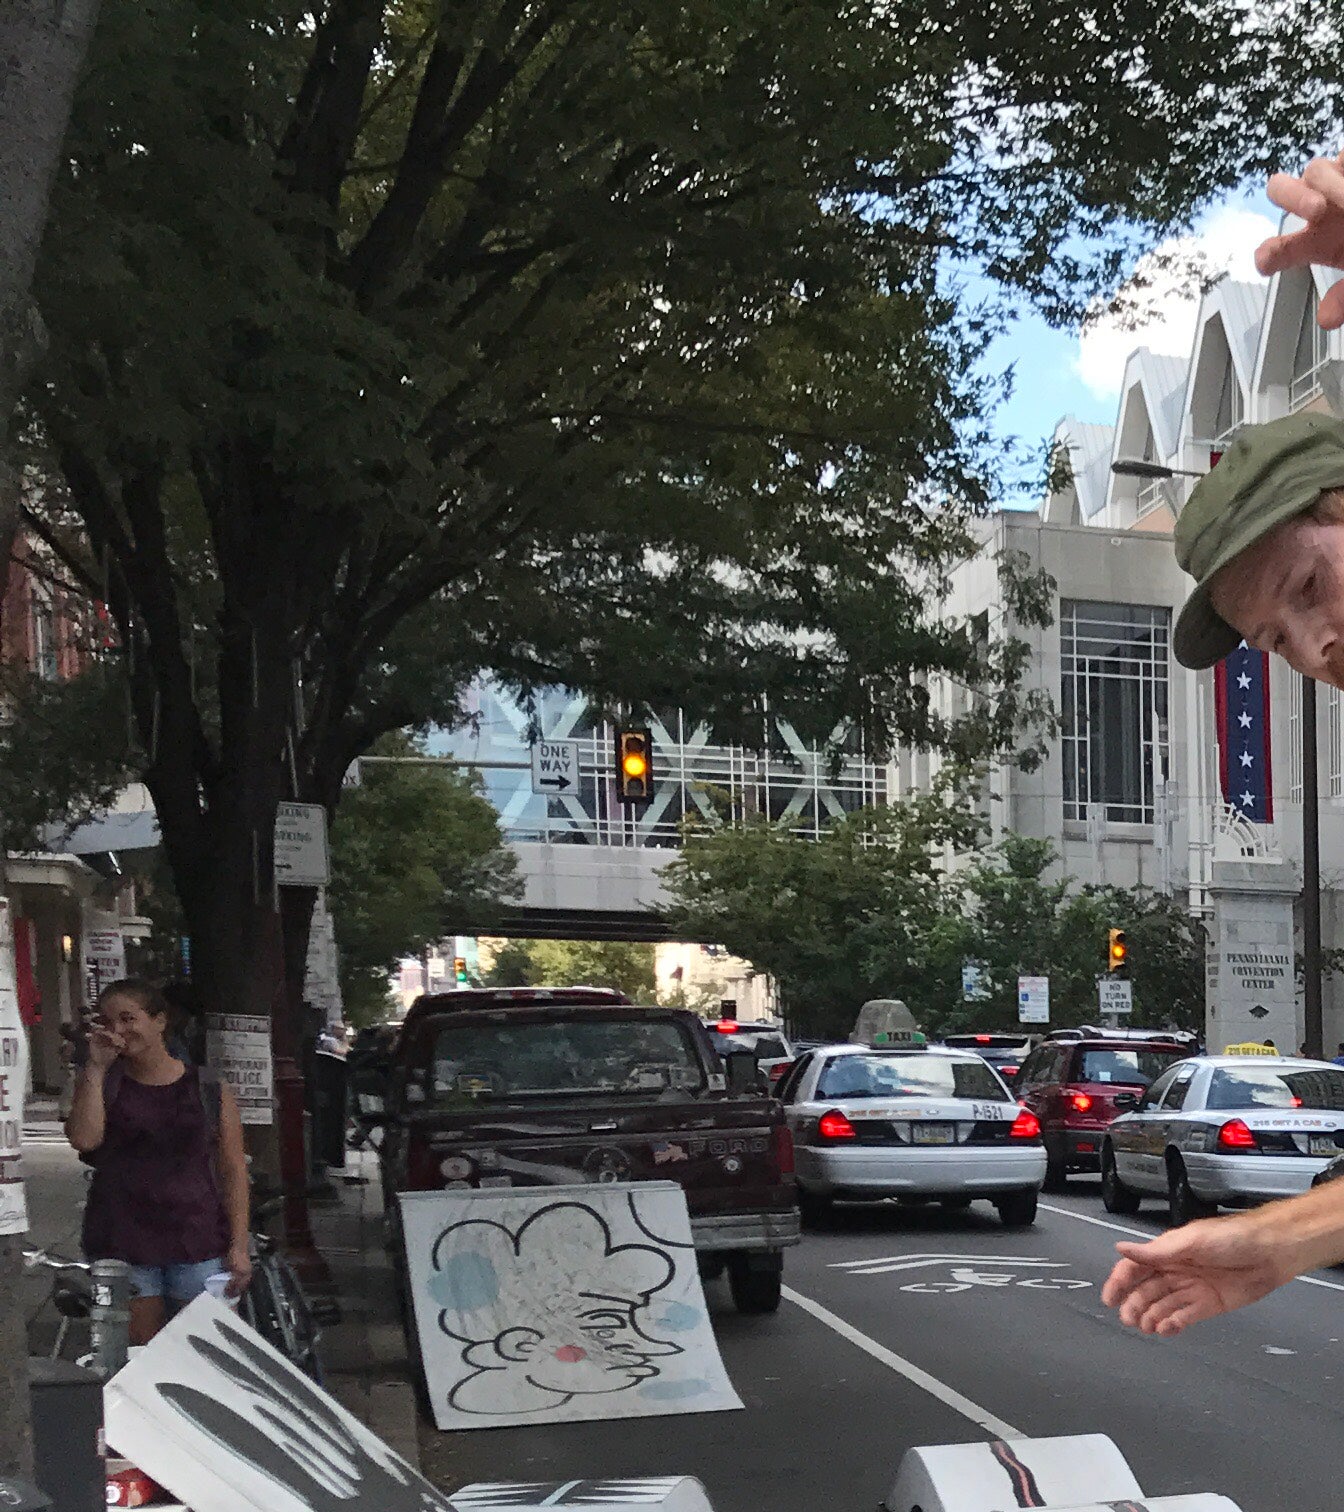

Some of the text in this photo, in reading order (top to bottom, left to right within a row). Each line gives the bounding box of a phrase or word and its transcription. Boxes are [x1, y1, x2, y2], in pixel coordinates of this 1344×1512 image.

[540, 744, 570, 759] ONE
[540, 760, 571, 772] WAY
[1226, 953, 1290, 965] PENNSYLVANIA
[1232, 966, 1285, 977] CONVENTION
[1109, 983, 1122, 991] NO
[1241, 979, 1275, 989] CENTER
[1104, 992, 1127, 1000] TURN
[1101, 1001, 1131, 1009] ON RED
[887, 1031, 912, 1041] TAXI
